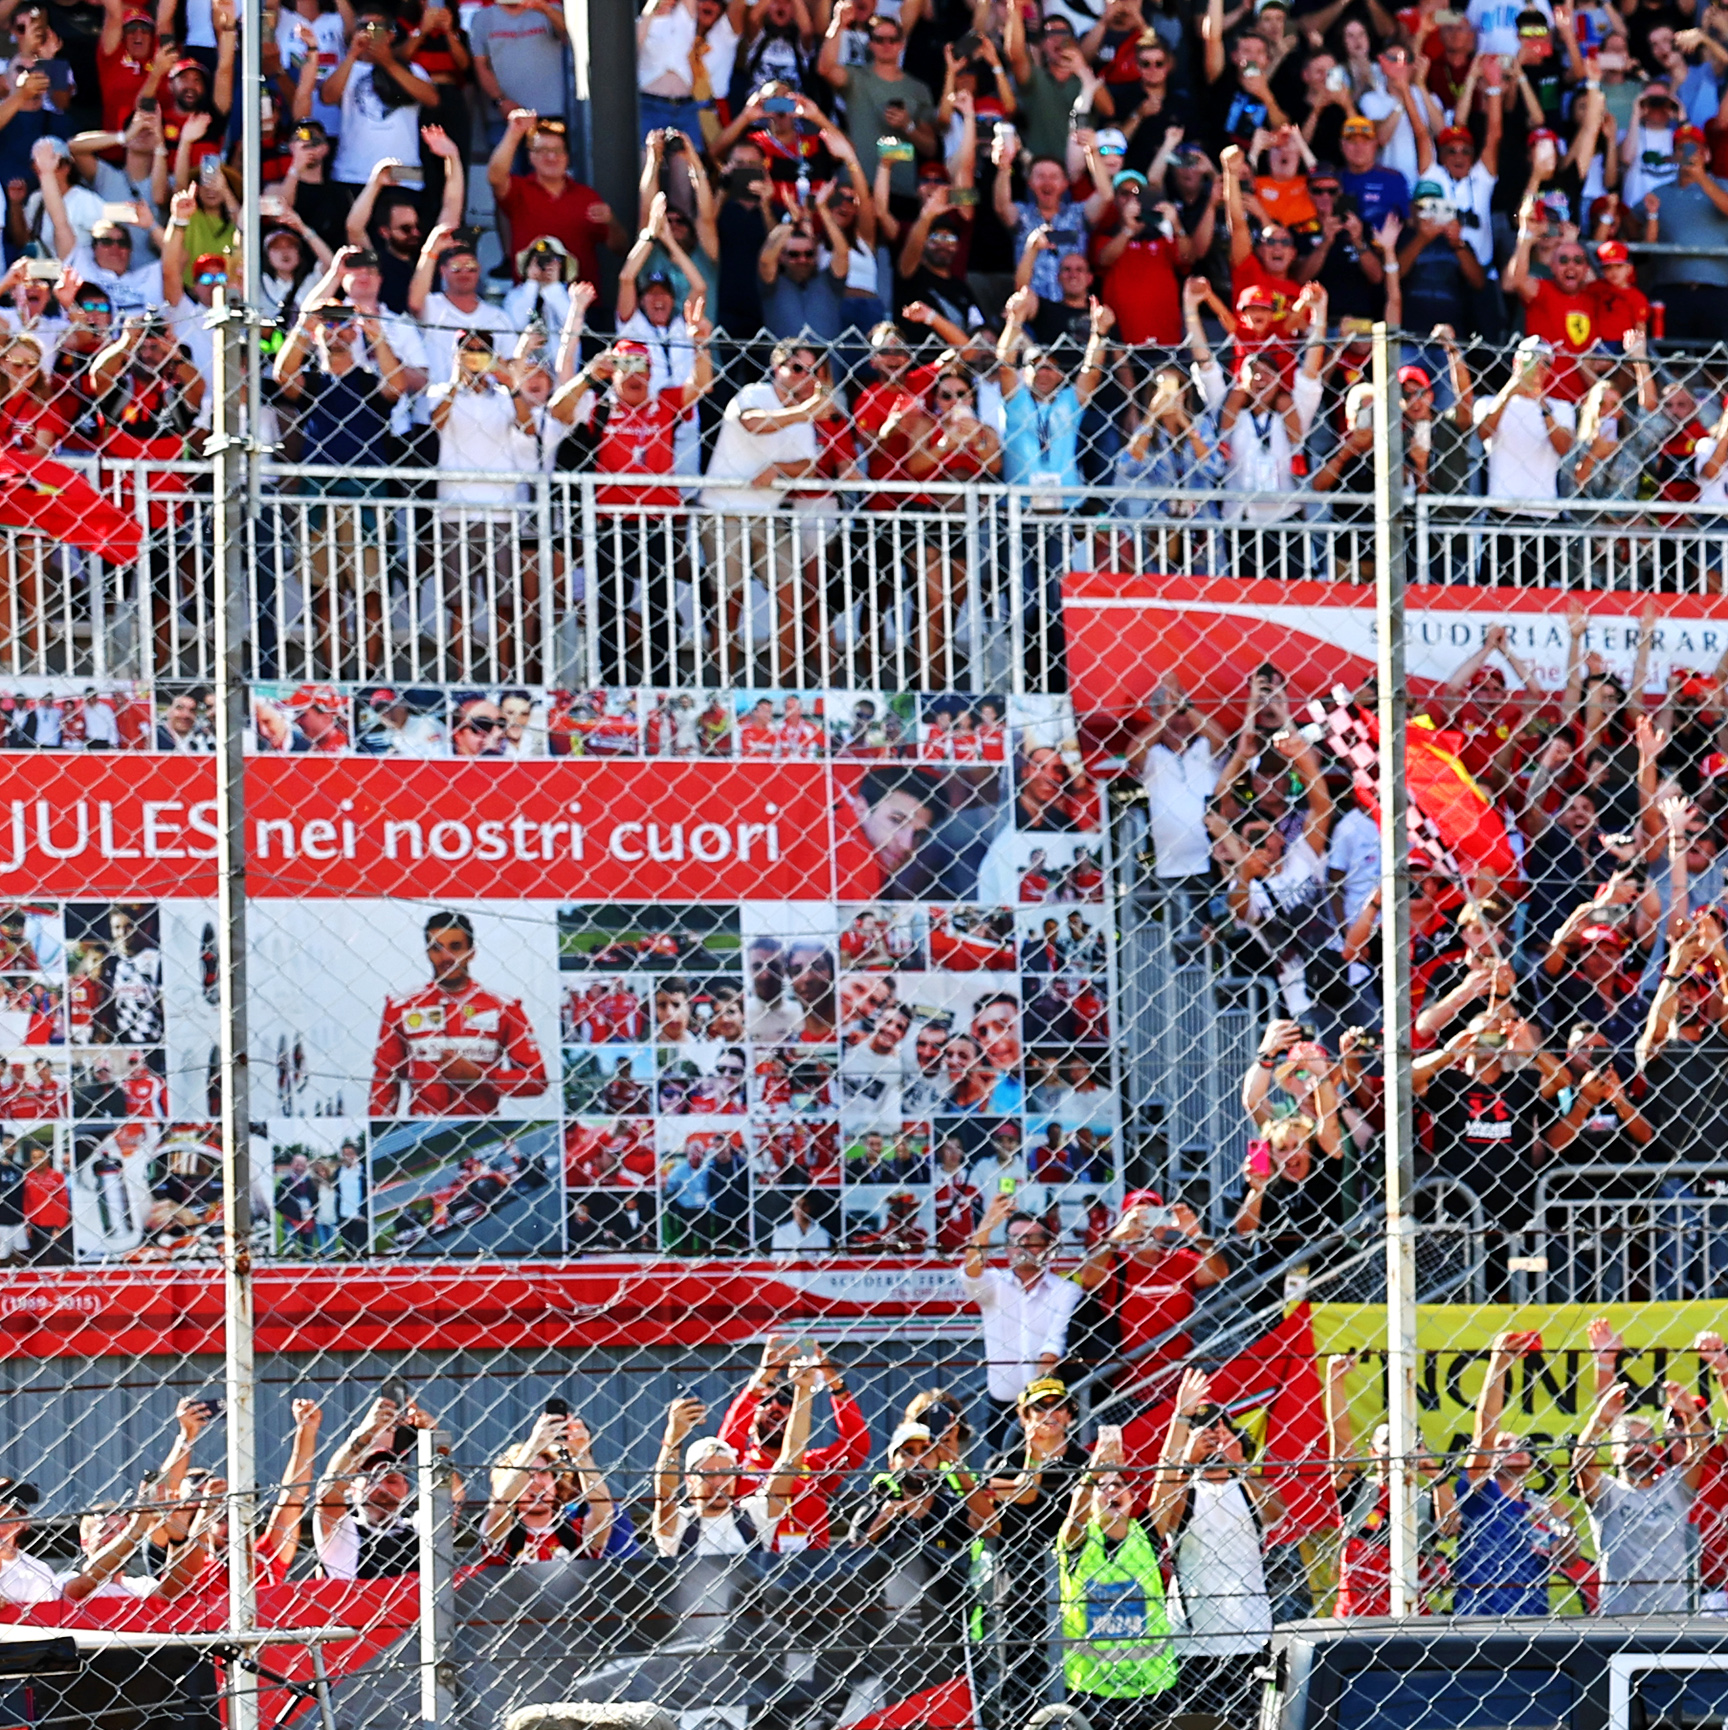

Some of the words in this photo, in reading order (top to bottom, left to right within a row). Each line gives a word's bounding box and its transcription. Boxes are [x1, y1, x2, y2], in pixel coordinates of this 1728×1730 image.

[0, 800, 219, 874] JULES
[256, 799, 357, 860] nei
[394, 803, 583, 863] nostri
[611, 803, 781, 863] cuori
